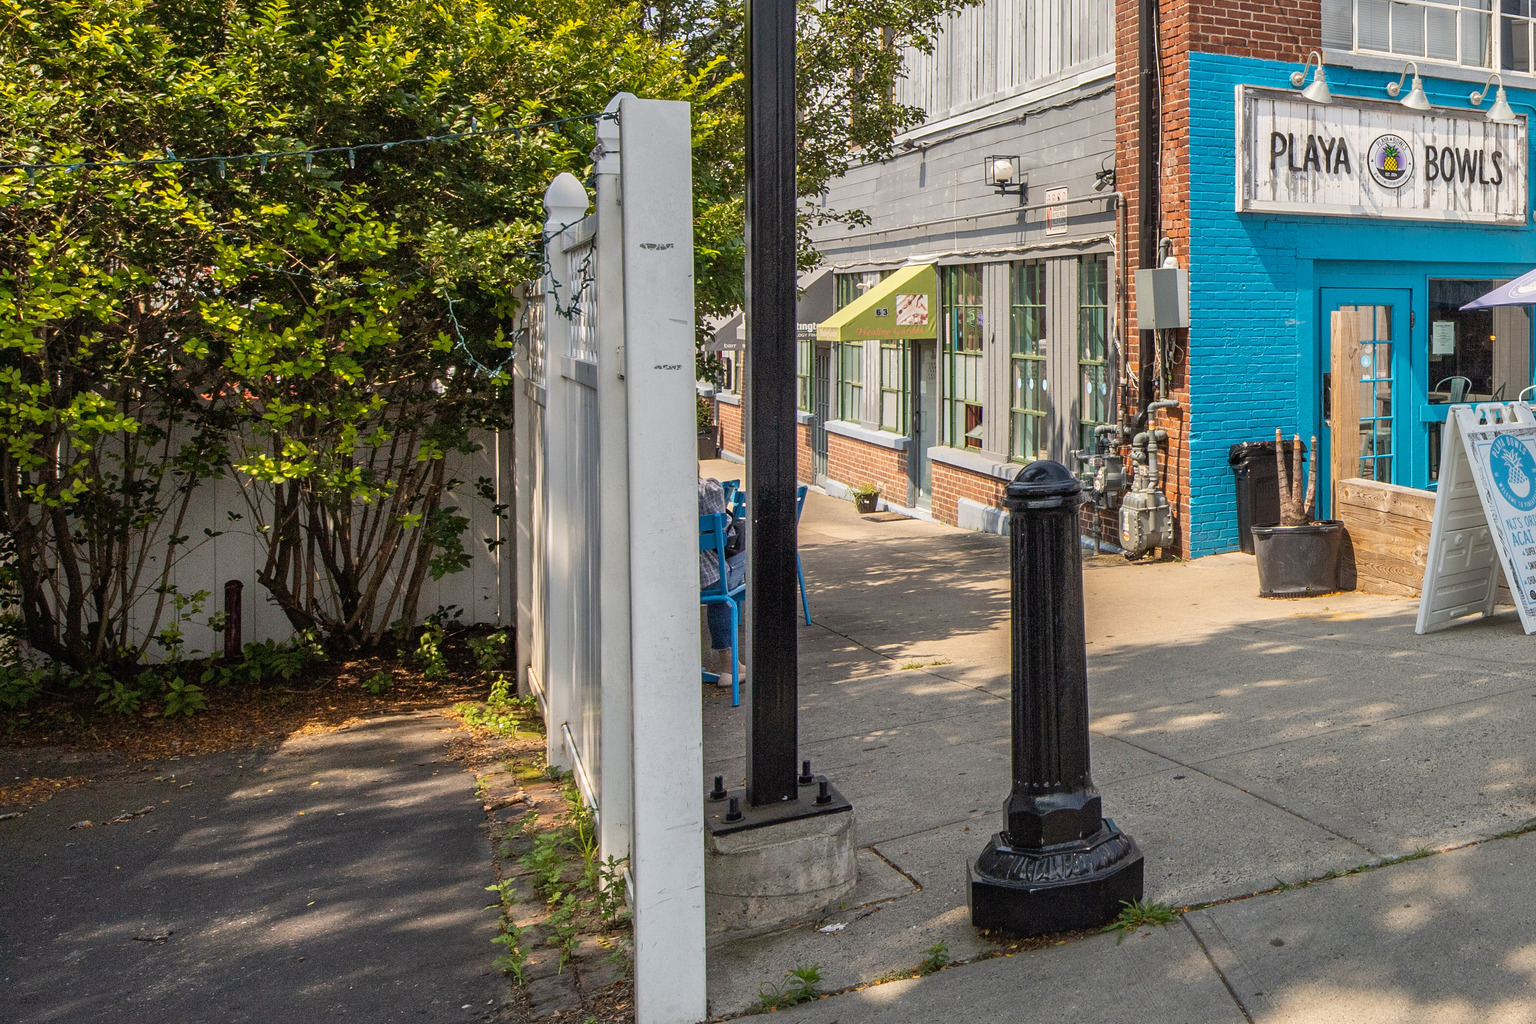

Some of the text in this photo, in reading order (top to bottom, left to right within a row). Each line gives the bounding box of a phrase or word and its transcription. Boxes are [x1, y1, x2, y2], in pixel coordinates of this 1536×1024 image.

[1270, 131, 1503, 186] PLAYA BOWLS
[876, 308, 888, 316] 63
[856, 326, 925, 338] Healing Garden
[1505, 516, 1524, 531] NJ'S
[1511, 529, 1535, 548] ACAI
